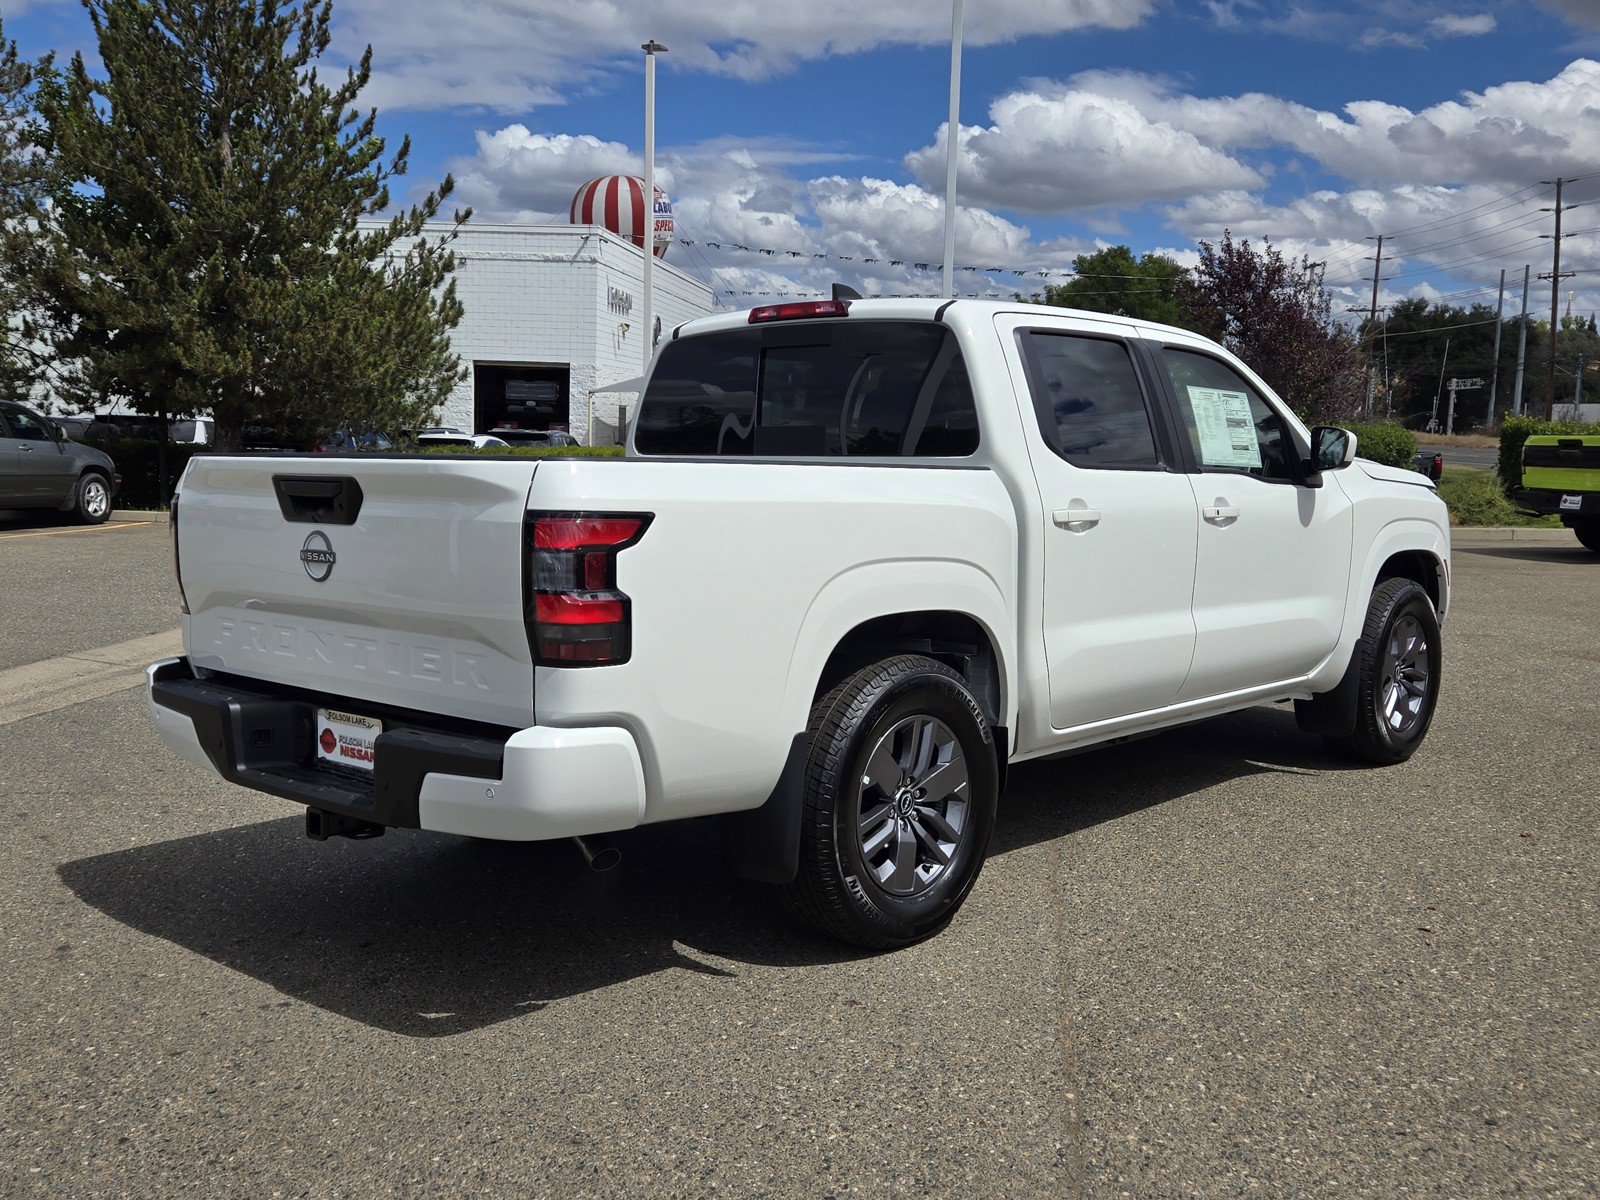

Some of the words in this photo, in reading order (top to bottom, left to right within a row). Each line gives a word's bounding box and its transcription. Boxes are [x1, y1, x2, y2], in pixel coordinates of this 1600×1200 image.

[301, 551, 334, 562] NISSAN
[213, 615, 490, 690] FRONTIER
[326, 711, 351, 722] FOLSOM
[351, 716, 366, 725] LAKE
[954, 688, 991, 740] MICHELIN
[338, 734, 362, 748] FOLSOM
